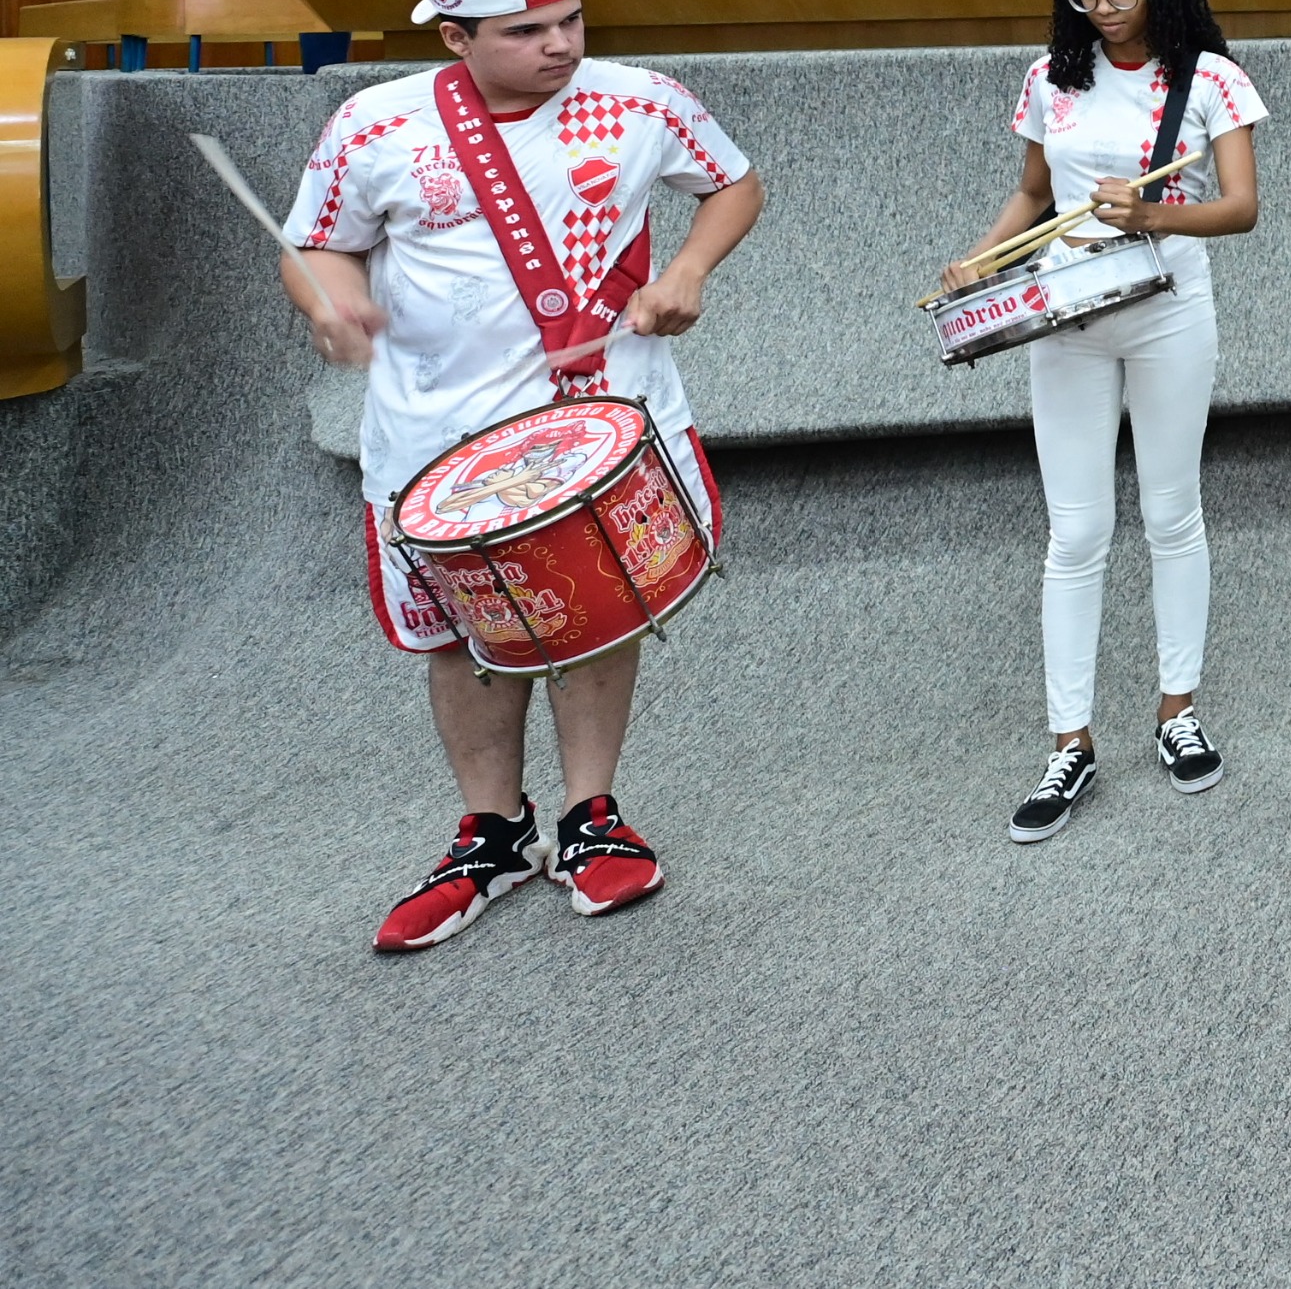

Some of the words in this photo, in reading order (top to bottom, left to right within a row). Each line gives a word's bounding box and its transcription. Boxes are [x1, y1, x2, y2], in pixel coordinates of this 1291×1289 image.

[445, 80, 484, 145] ritmo
[475, 151, 543, 272] responsa
[563, 842, 641, 862] Champion
[412, 860, 496, 895] Champion
